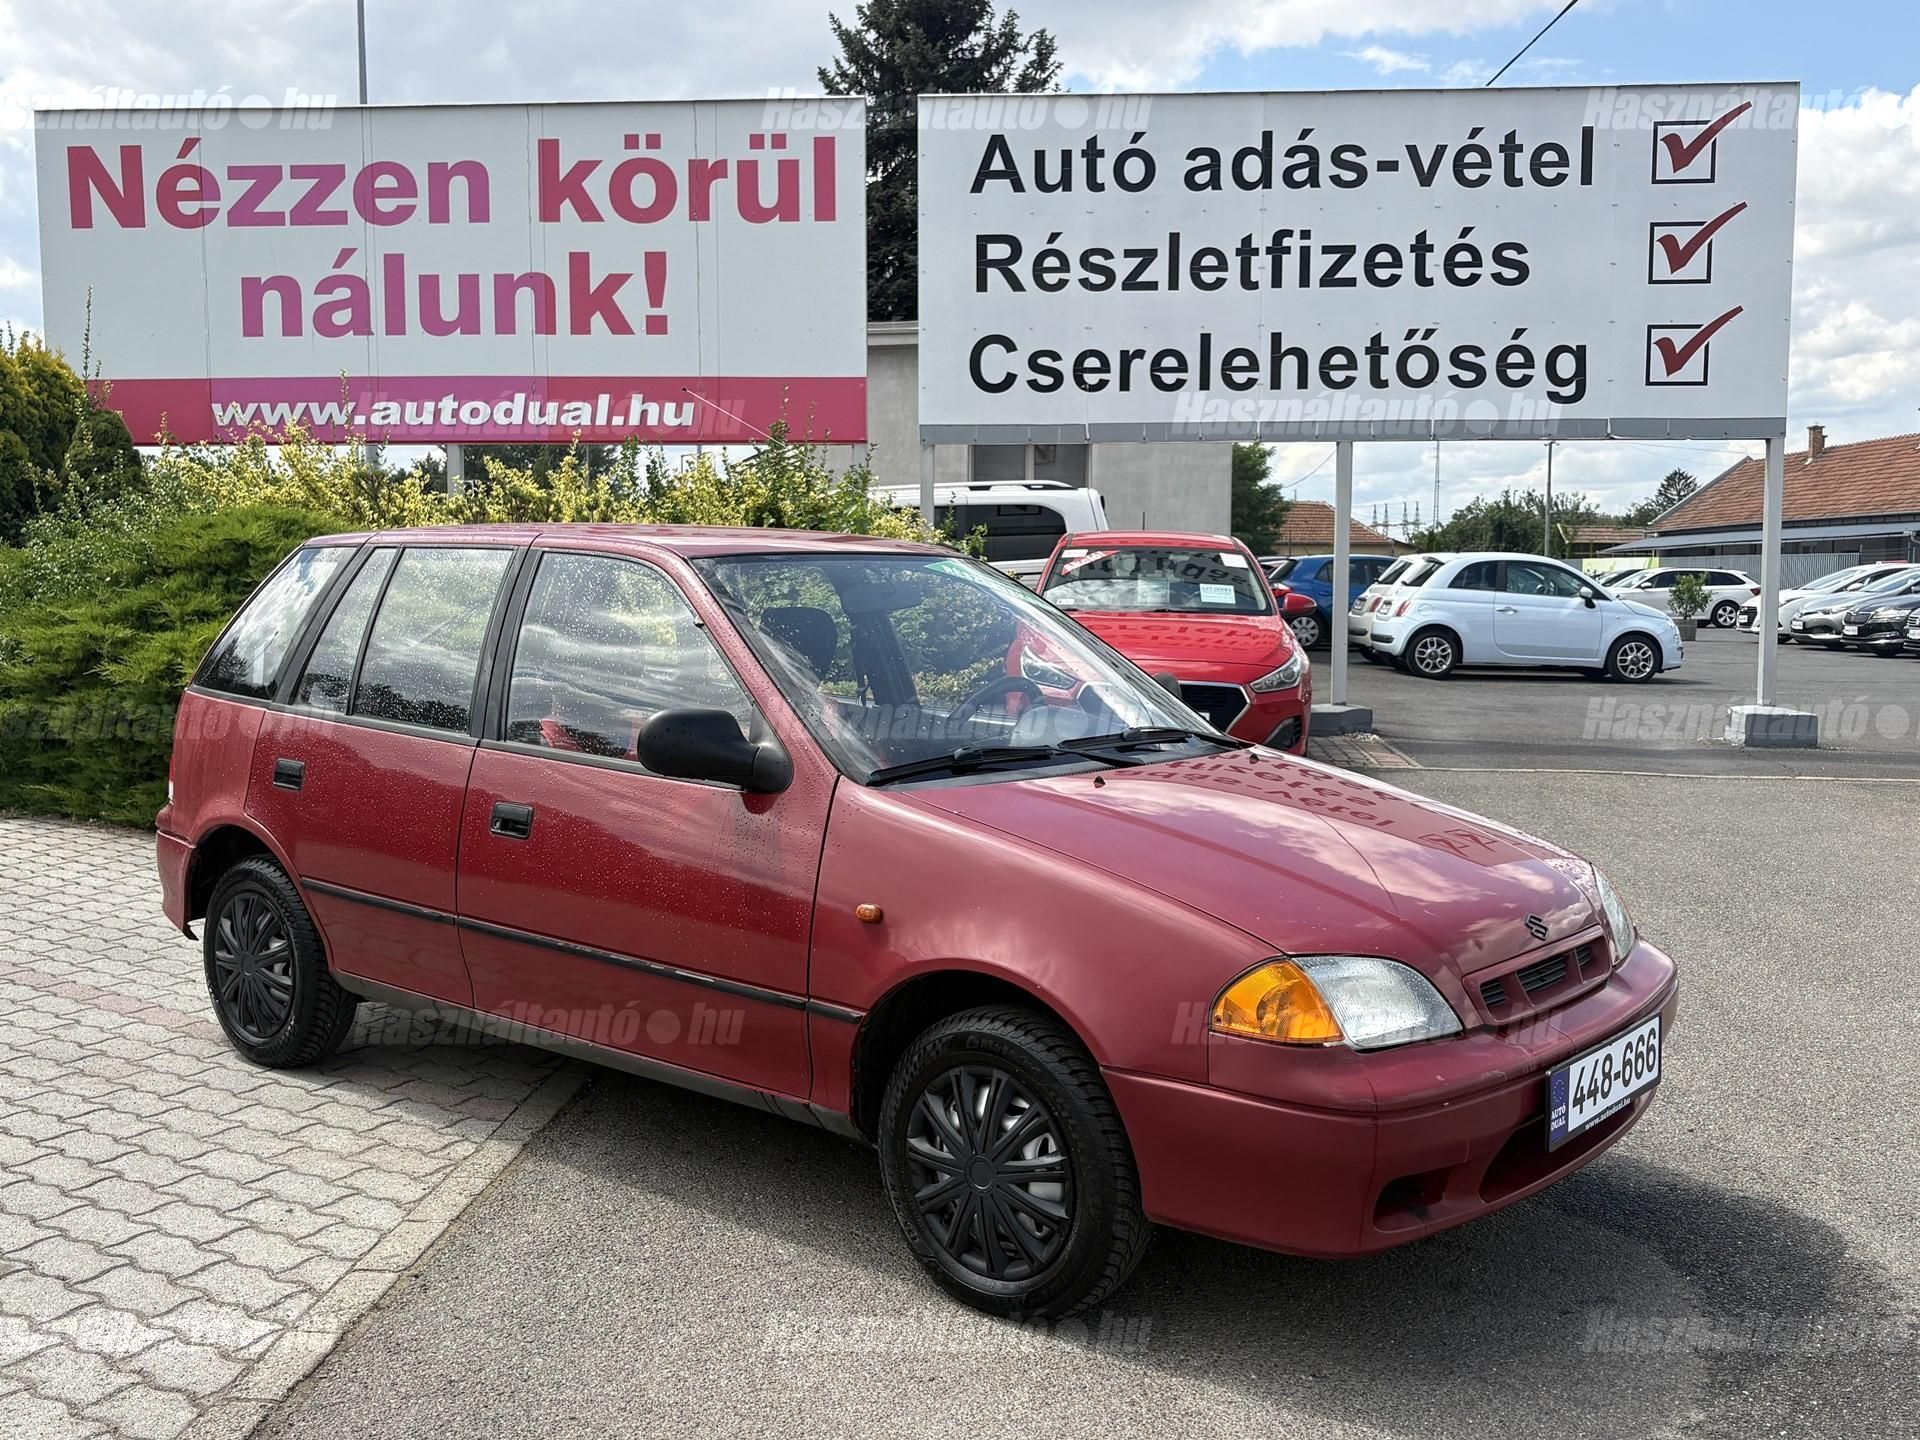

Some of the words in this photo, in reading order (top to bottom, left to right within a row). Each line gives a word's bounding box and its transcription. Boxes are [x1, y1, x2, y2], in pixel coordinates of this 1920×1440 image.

[67, 138, 490, 229] Nézzen
[538, 133, 836, 224] körül
[969, 131, 1157, 193] Autó
[1184, 126, 1594, 192] adás-vétel
[241, 248, 668, 338] nálunk!
[976, 226, 1530, 293] Részletfizetés
[969, 328, 1587, 405] Cserelehetőség
[211, 393, 696, 426] www.autodual.hu
[1572, 1027, 1656, 1115] 448-666
